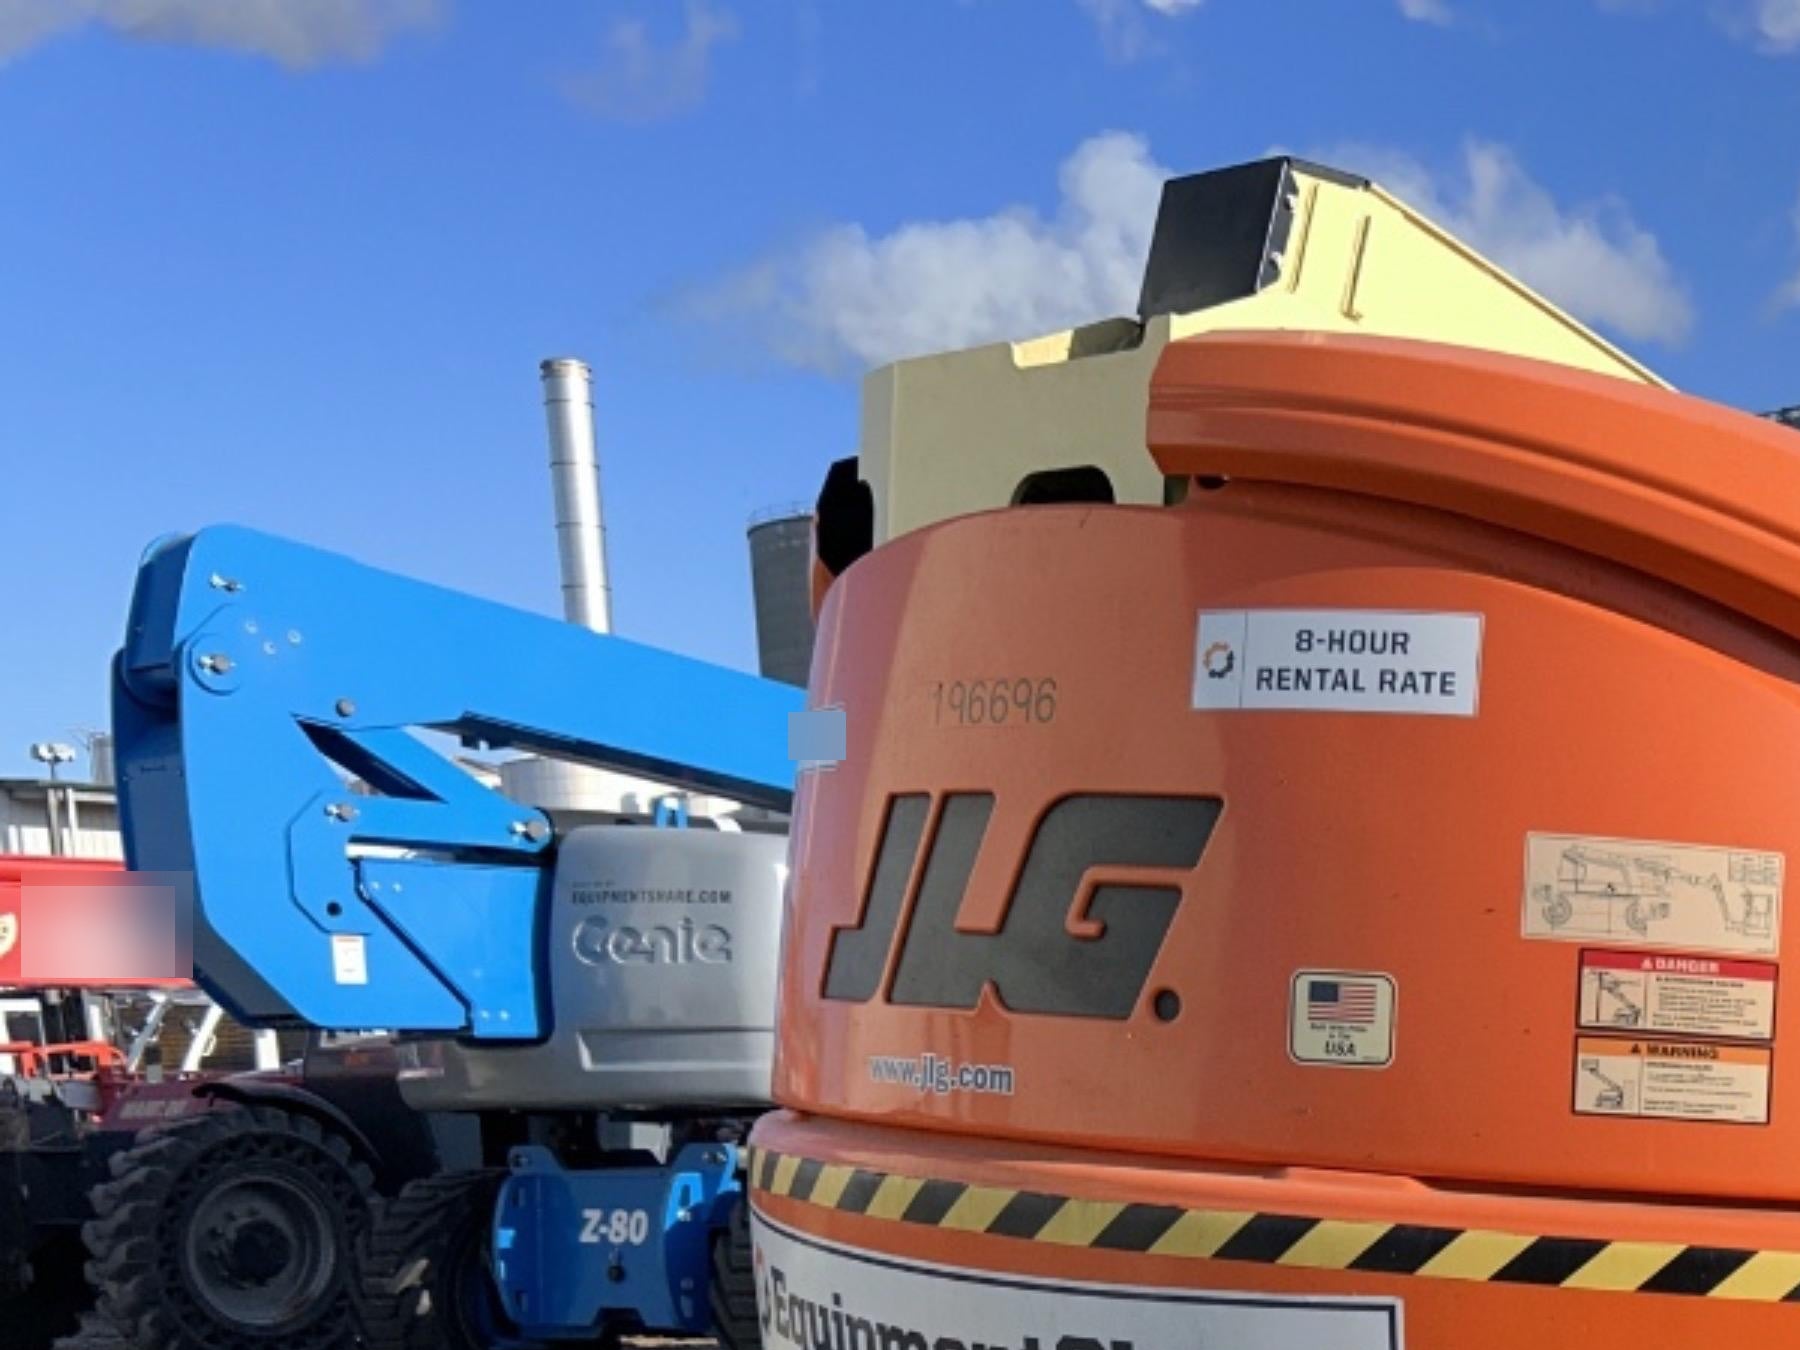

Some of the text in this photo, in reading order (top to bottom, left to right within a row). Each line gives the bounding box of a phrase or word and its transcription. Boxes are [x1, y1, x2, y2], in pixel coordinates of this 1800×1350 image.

[1295, 629, 1411, 655] 8-HOUR
[1256, 667, 1457, 697] RENTAL RATE
[931, 677, 1057, 726] 196696
[572, 914, 733, 966] Genie
[1655, 956, 1720, 974] DANGER
[870, 1052, 1014, 1095] www.jlg.com
[579, 1208, 649, 1246] Z-80
